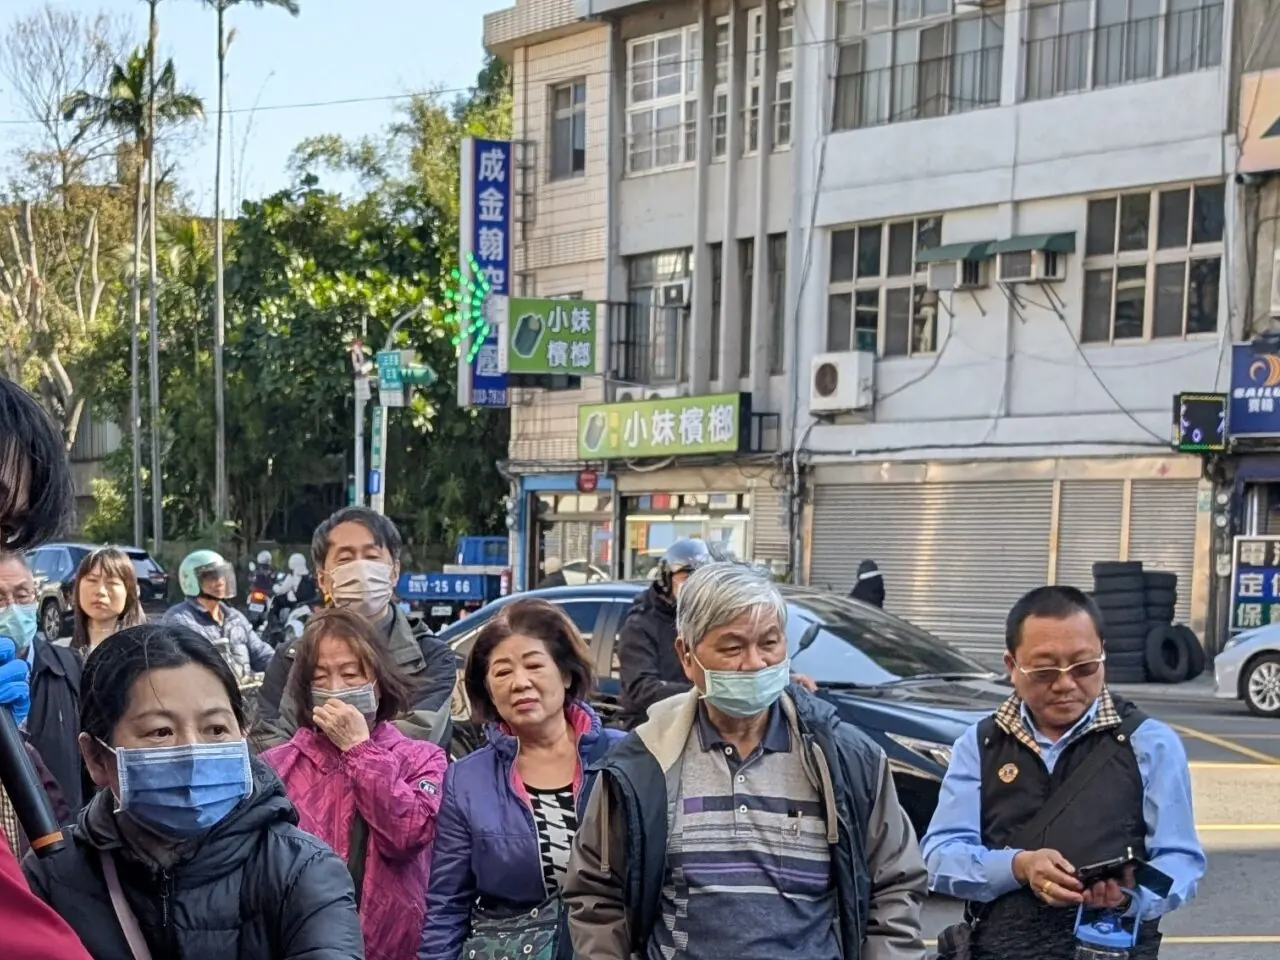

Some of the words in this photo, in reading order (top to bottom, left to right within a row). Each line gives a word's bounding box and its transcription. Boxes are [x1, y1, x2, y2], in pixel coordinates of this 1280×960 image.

[547, 306, 591, 334] 小妹
[547, 341, 591, 367] 檳榔
[623, 404, 734, 448] 小妹檳榔
